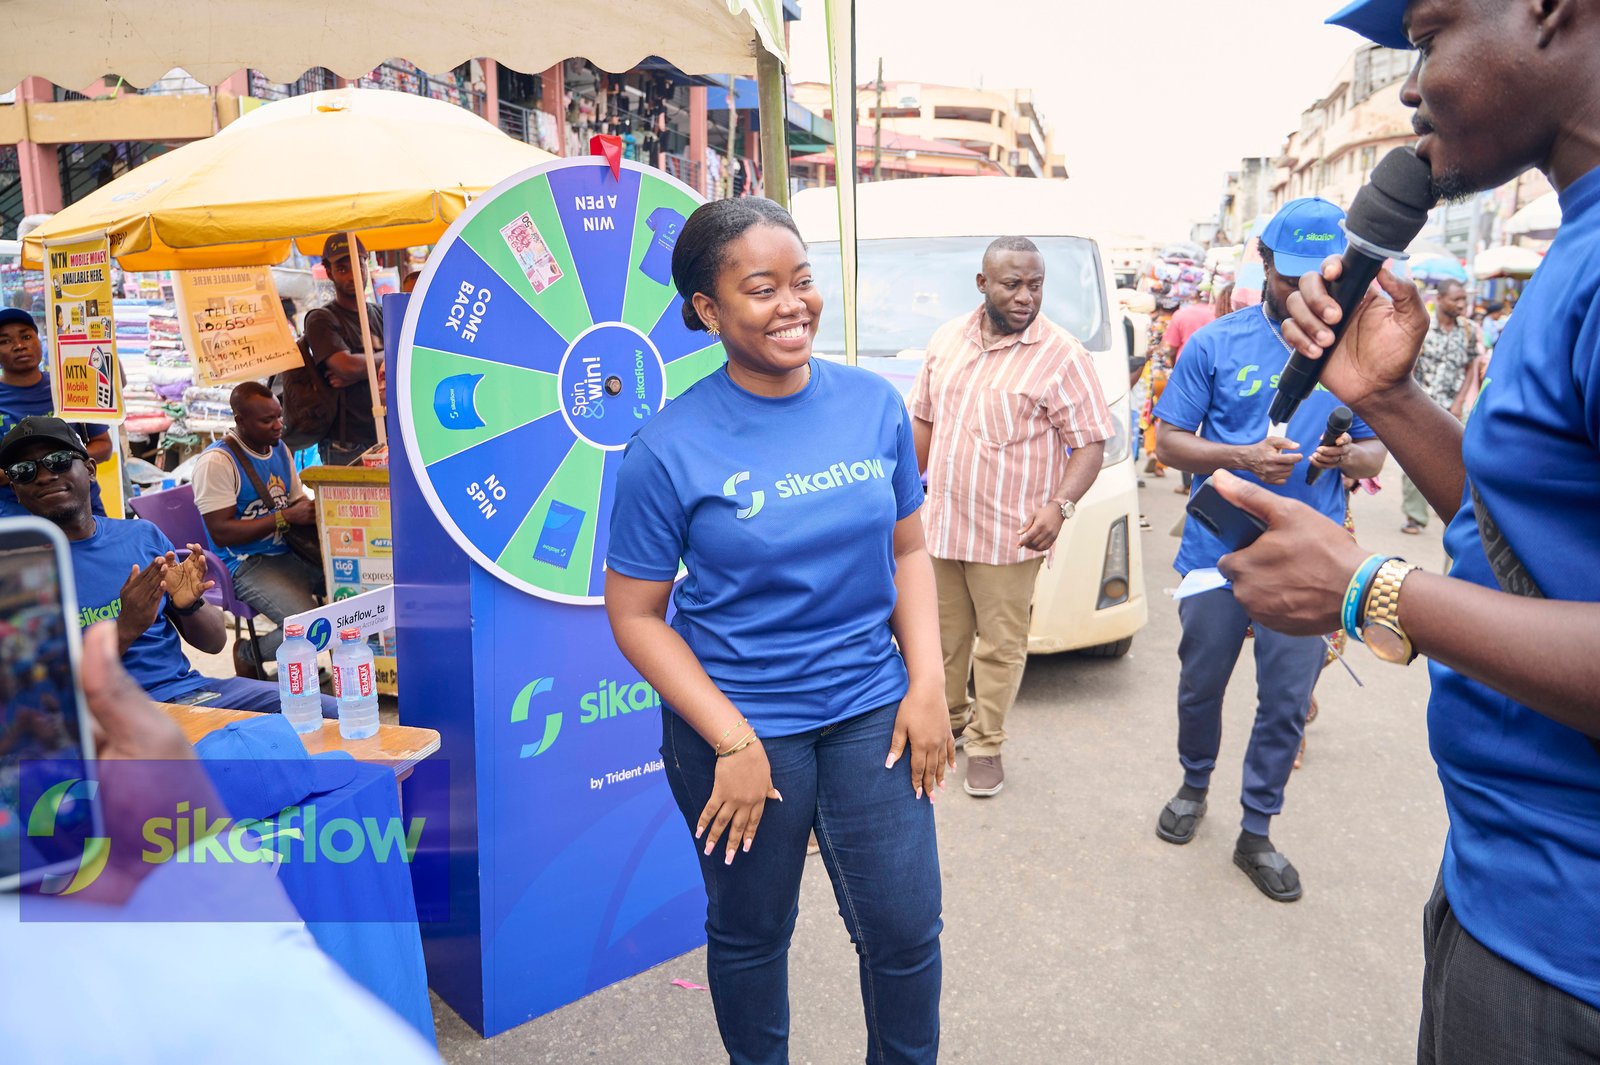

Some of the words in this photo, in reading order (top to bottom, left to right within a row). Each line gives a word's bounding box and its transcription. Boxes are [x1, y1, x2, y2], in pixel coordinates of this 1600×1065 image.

[575, 195, 604, 211] PEN
[607, 194, 618, 209] A
[583, 216, 615, 232] WIN
[50, 252, 67, 269] MTN
[70, 254, 89, 267] MOBILE
[90, 250, 107, 264] MONEY
[63, 271, 89, 285] AVAILABLE
[445, 280, 475, 332] BACK
[461, 288, 492, 343] COME
[65, 365, 87, 379] MTN
[634, 349, 646, 400] sikaflow
[66, 382, 88, 391] Mobile
[67, 394, 89, 405] Money
[571, 382, 587, 417] Spin
[484, 474, 507, 501] NO
[775, 459, 885, 498] sikaflow
[349, 505, 364, 518] SOLD
[466, 482, 497, 520] SPIN
[336, 604, 386, 629] Sikaflow_ta
[590, 777, 604, 790] by
[606, 766, 642, 785] Trident
